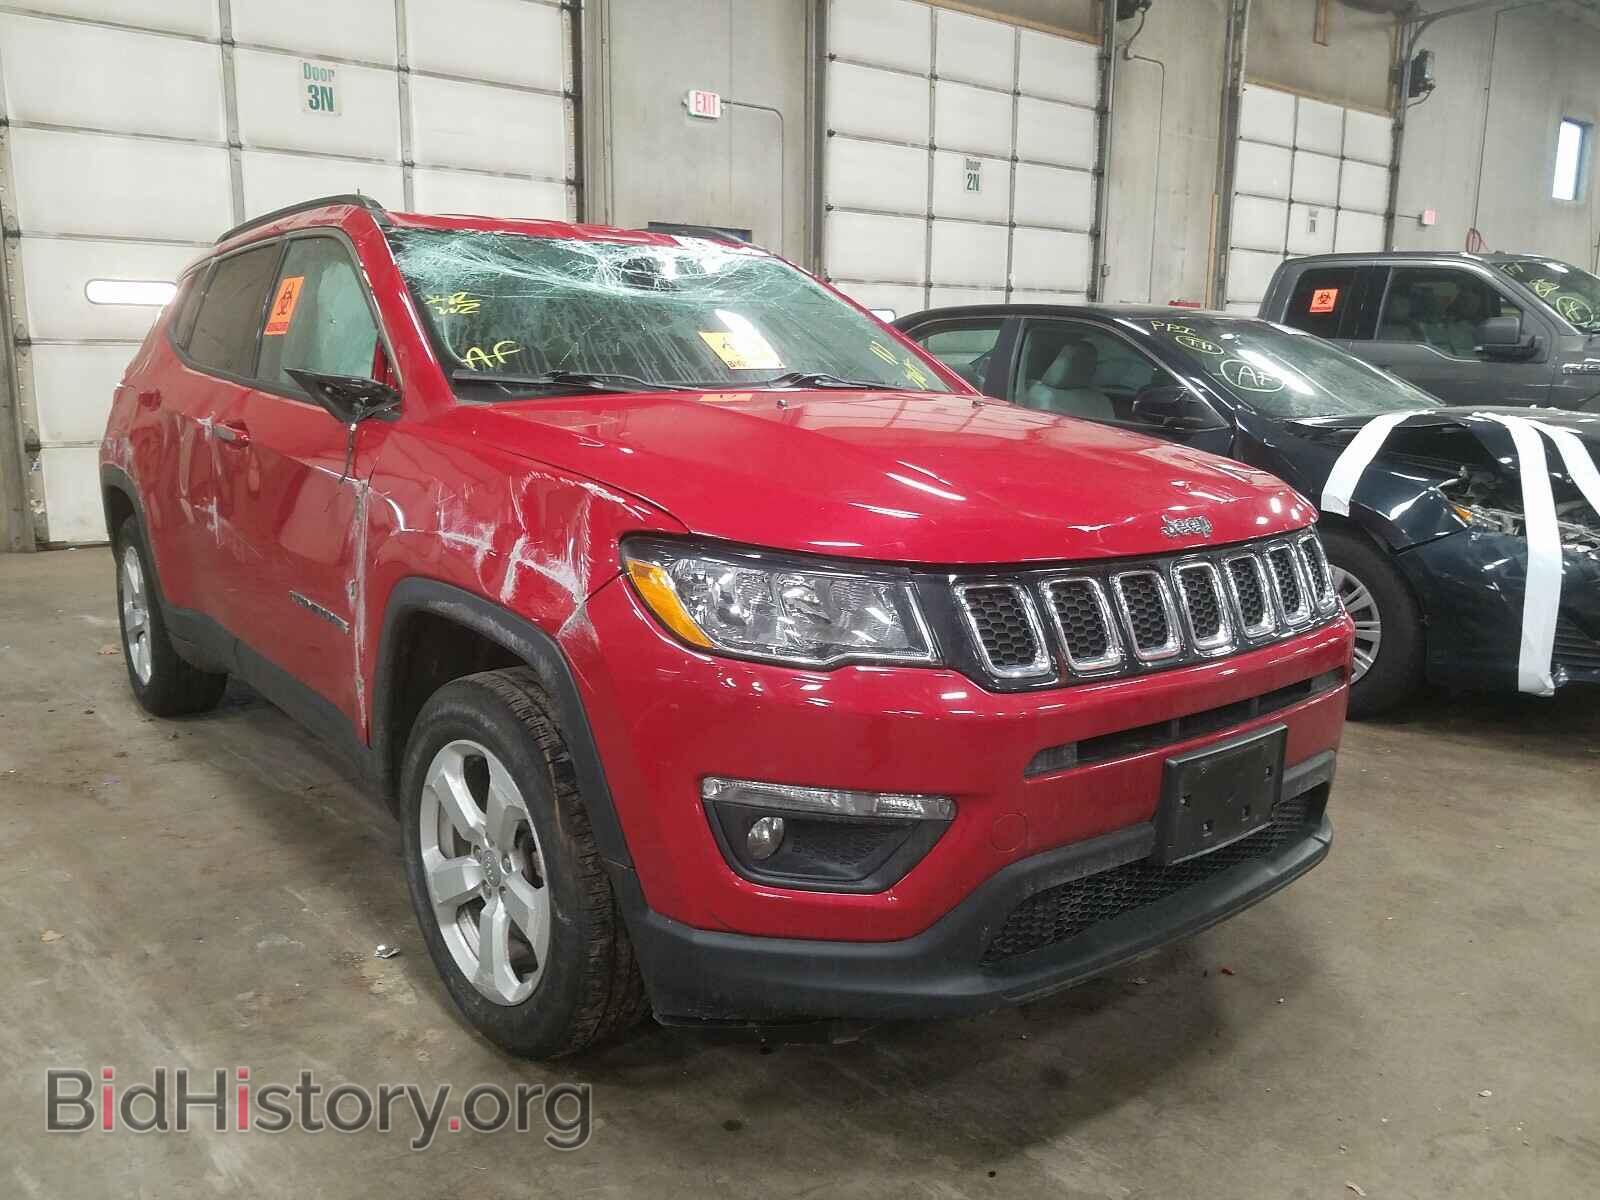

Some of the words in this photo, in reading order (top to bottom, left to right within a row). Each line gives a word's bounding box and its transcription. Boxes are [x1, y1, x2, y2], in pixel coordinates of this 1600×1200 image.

[303, 62, 335, 82] Door
[307, 84, 334, 112] 3N
[695, 91, 717, 115] EXIT
[967, 172, 980, 191] 2N
[1160, 514, 1213, 538] Jeep
